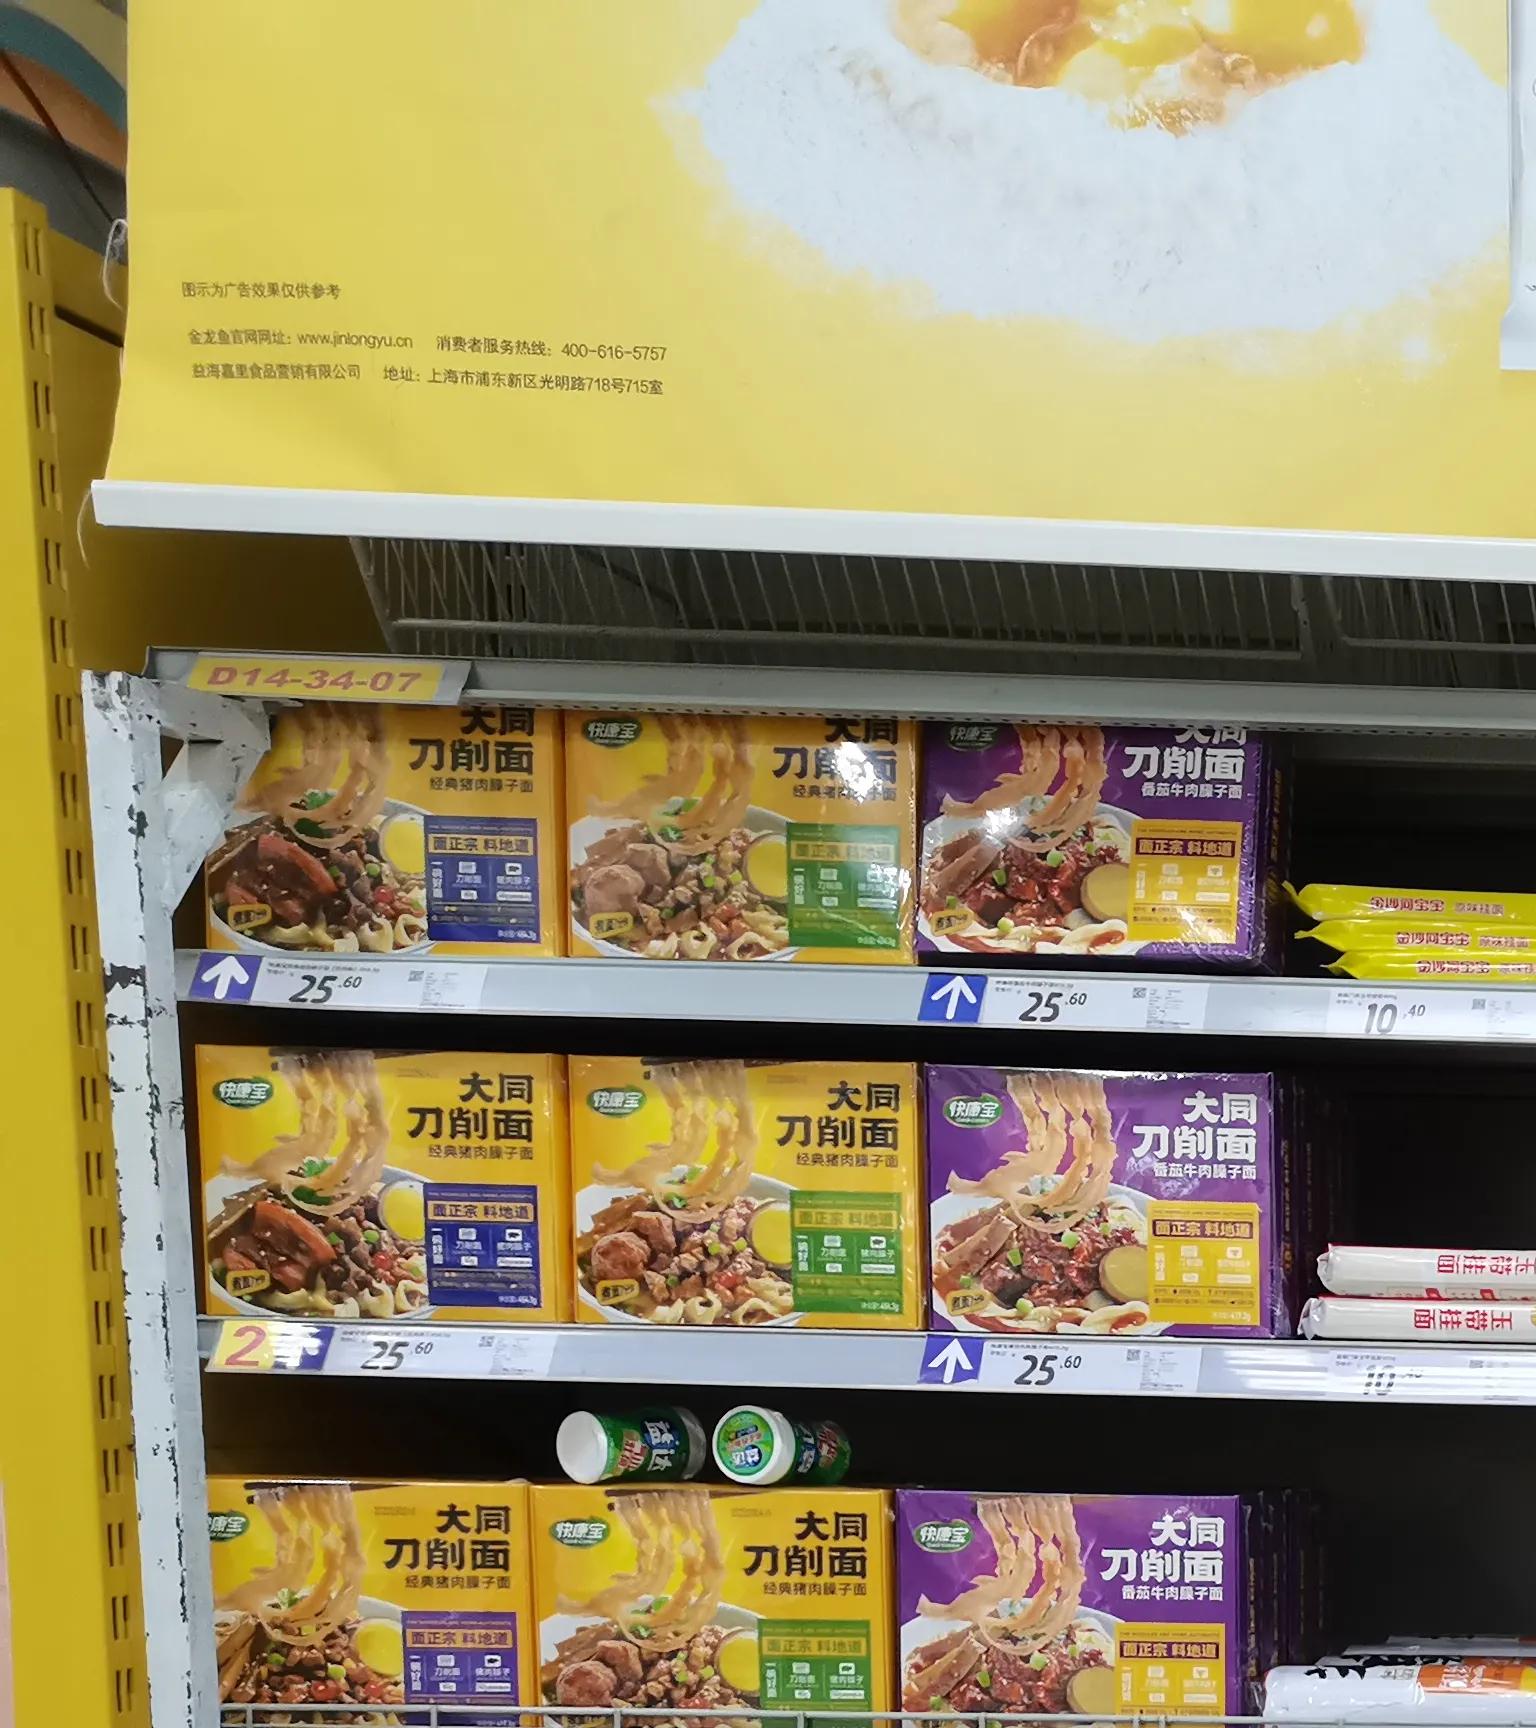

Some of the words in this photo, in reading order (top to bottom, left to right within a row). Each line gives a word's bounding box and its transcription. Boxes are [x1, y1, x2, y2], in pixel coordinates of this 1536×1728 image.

[208, 666, 423, 693] D14-34-07
[460, 706, 535, 736] 大同
[408, 738, 534, 775] 刀削面
[1122, 746, 1245, 782] 刀削面
[219, 1082, 270, 1099] 快康宝
[460, 1072, 534, 1105] 大同
[407, 1107, 534, 1142] 刀削面
[1183, 1091, 1258, 1125] 大同
[1132, 1126, 1257, 1162] 刀削面
[225, 1327, 265, 1366] 2
[437, 1504, 511, 1535] 大同
[555, 1521, 606, 1540] 快康宝
[919, 1524, 971, 1544] 快康宝
[1152, 1515, 1225, 1548] 大同
[383, 1540, 511, 1571] 刀削面
[743, 1546, 867, 1579] 刀削面
